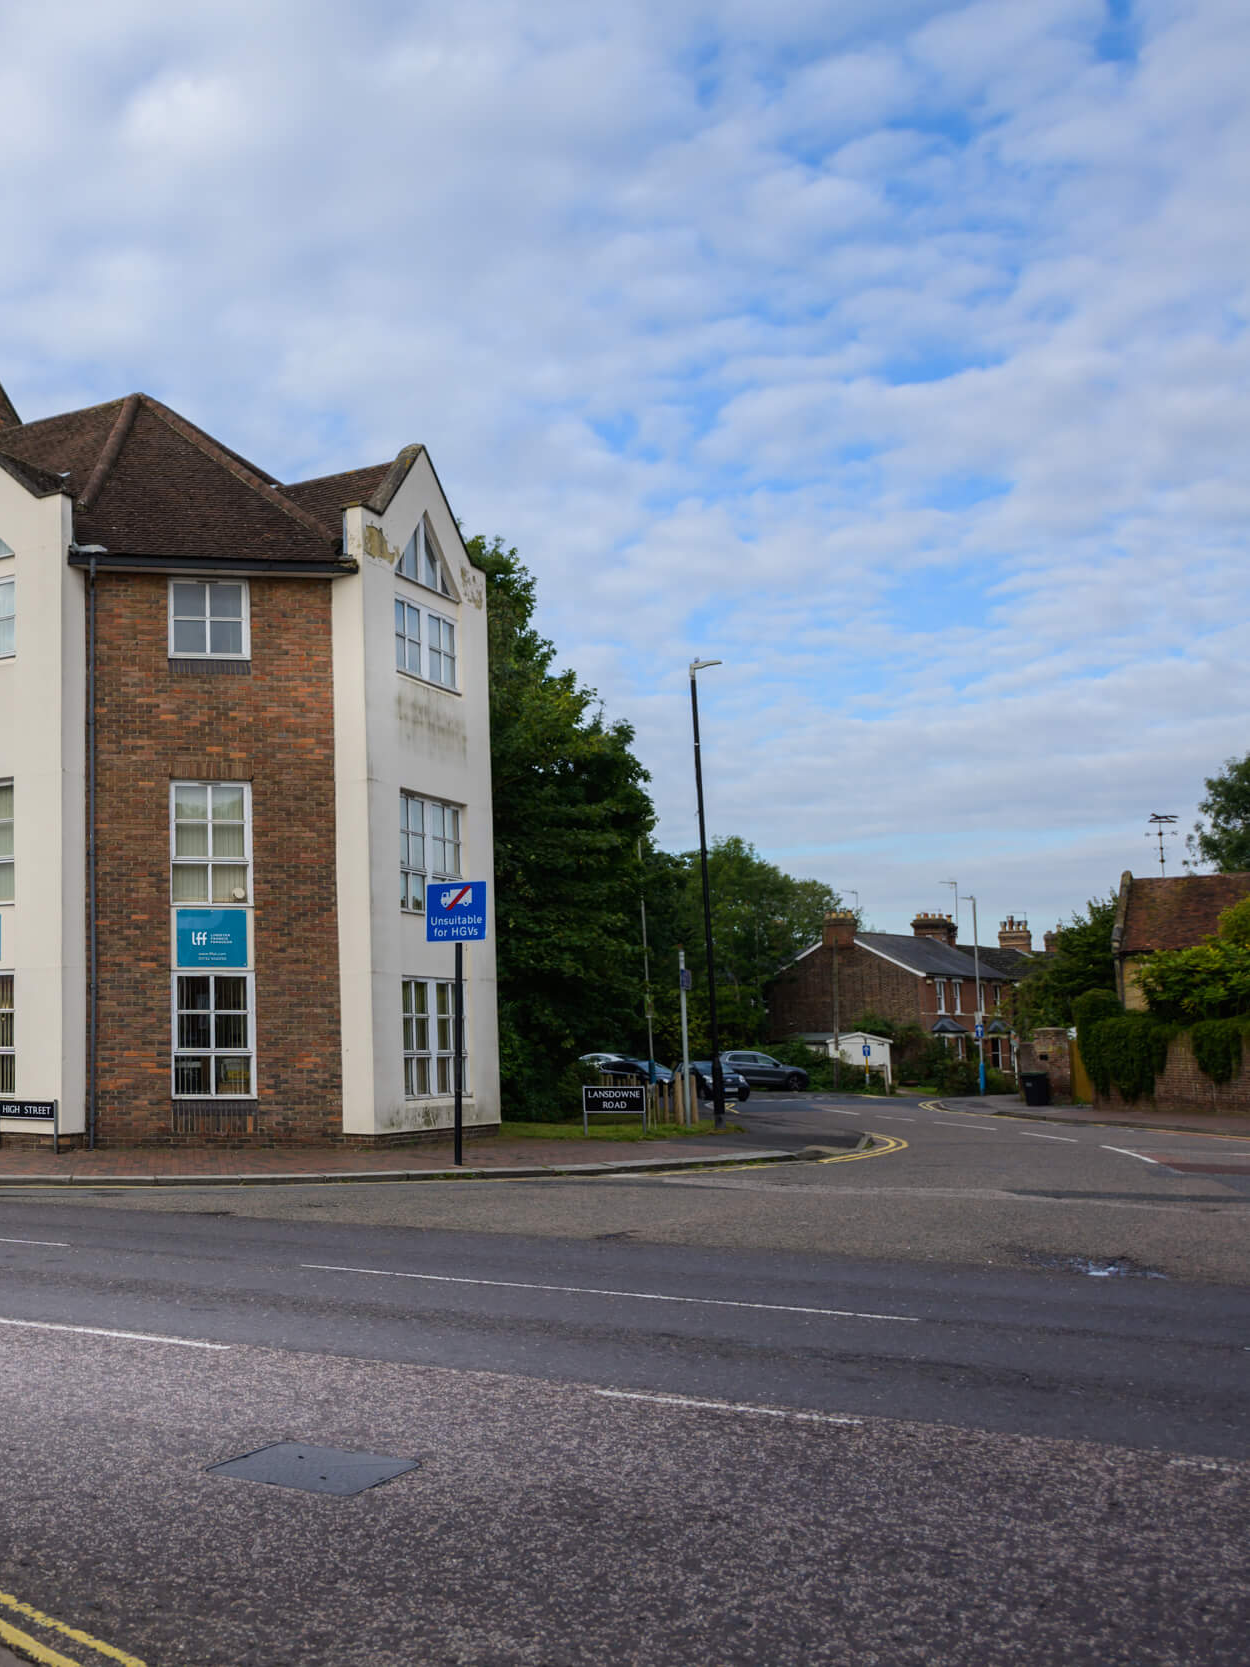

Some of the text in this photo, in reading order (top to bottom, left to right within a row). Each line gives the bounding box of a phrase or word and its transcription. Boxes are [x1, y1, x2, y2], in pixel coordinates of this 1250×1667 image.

[430, 915, 483, 926] Unsuitable
[434, 926, 478, 937] for HGVs
[588, 1090, 641, 1098] LANSDOWNE
[2, 1104, 52, 1115] HIGH STREET
[602, 1100, 627, 1109] ROAD
